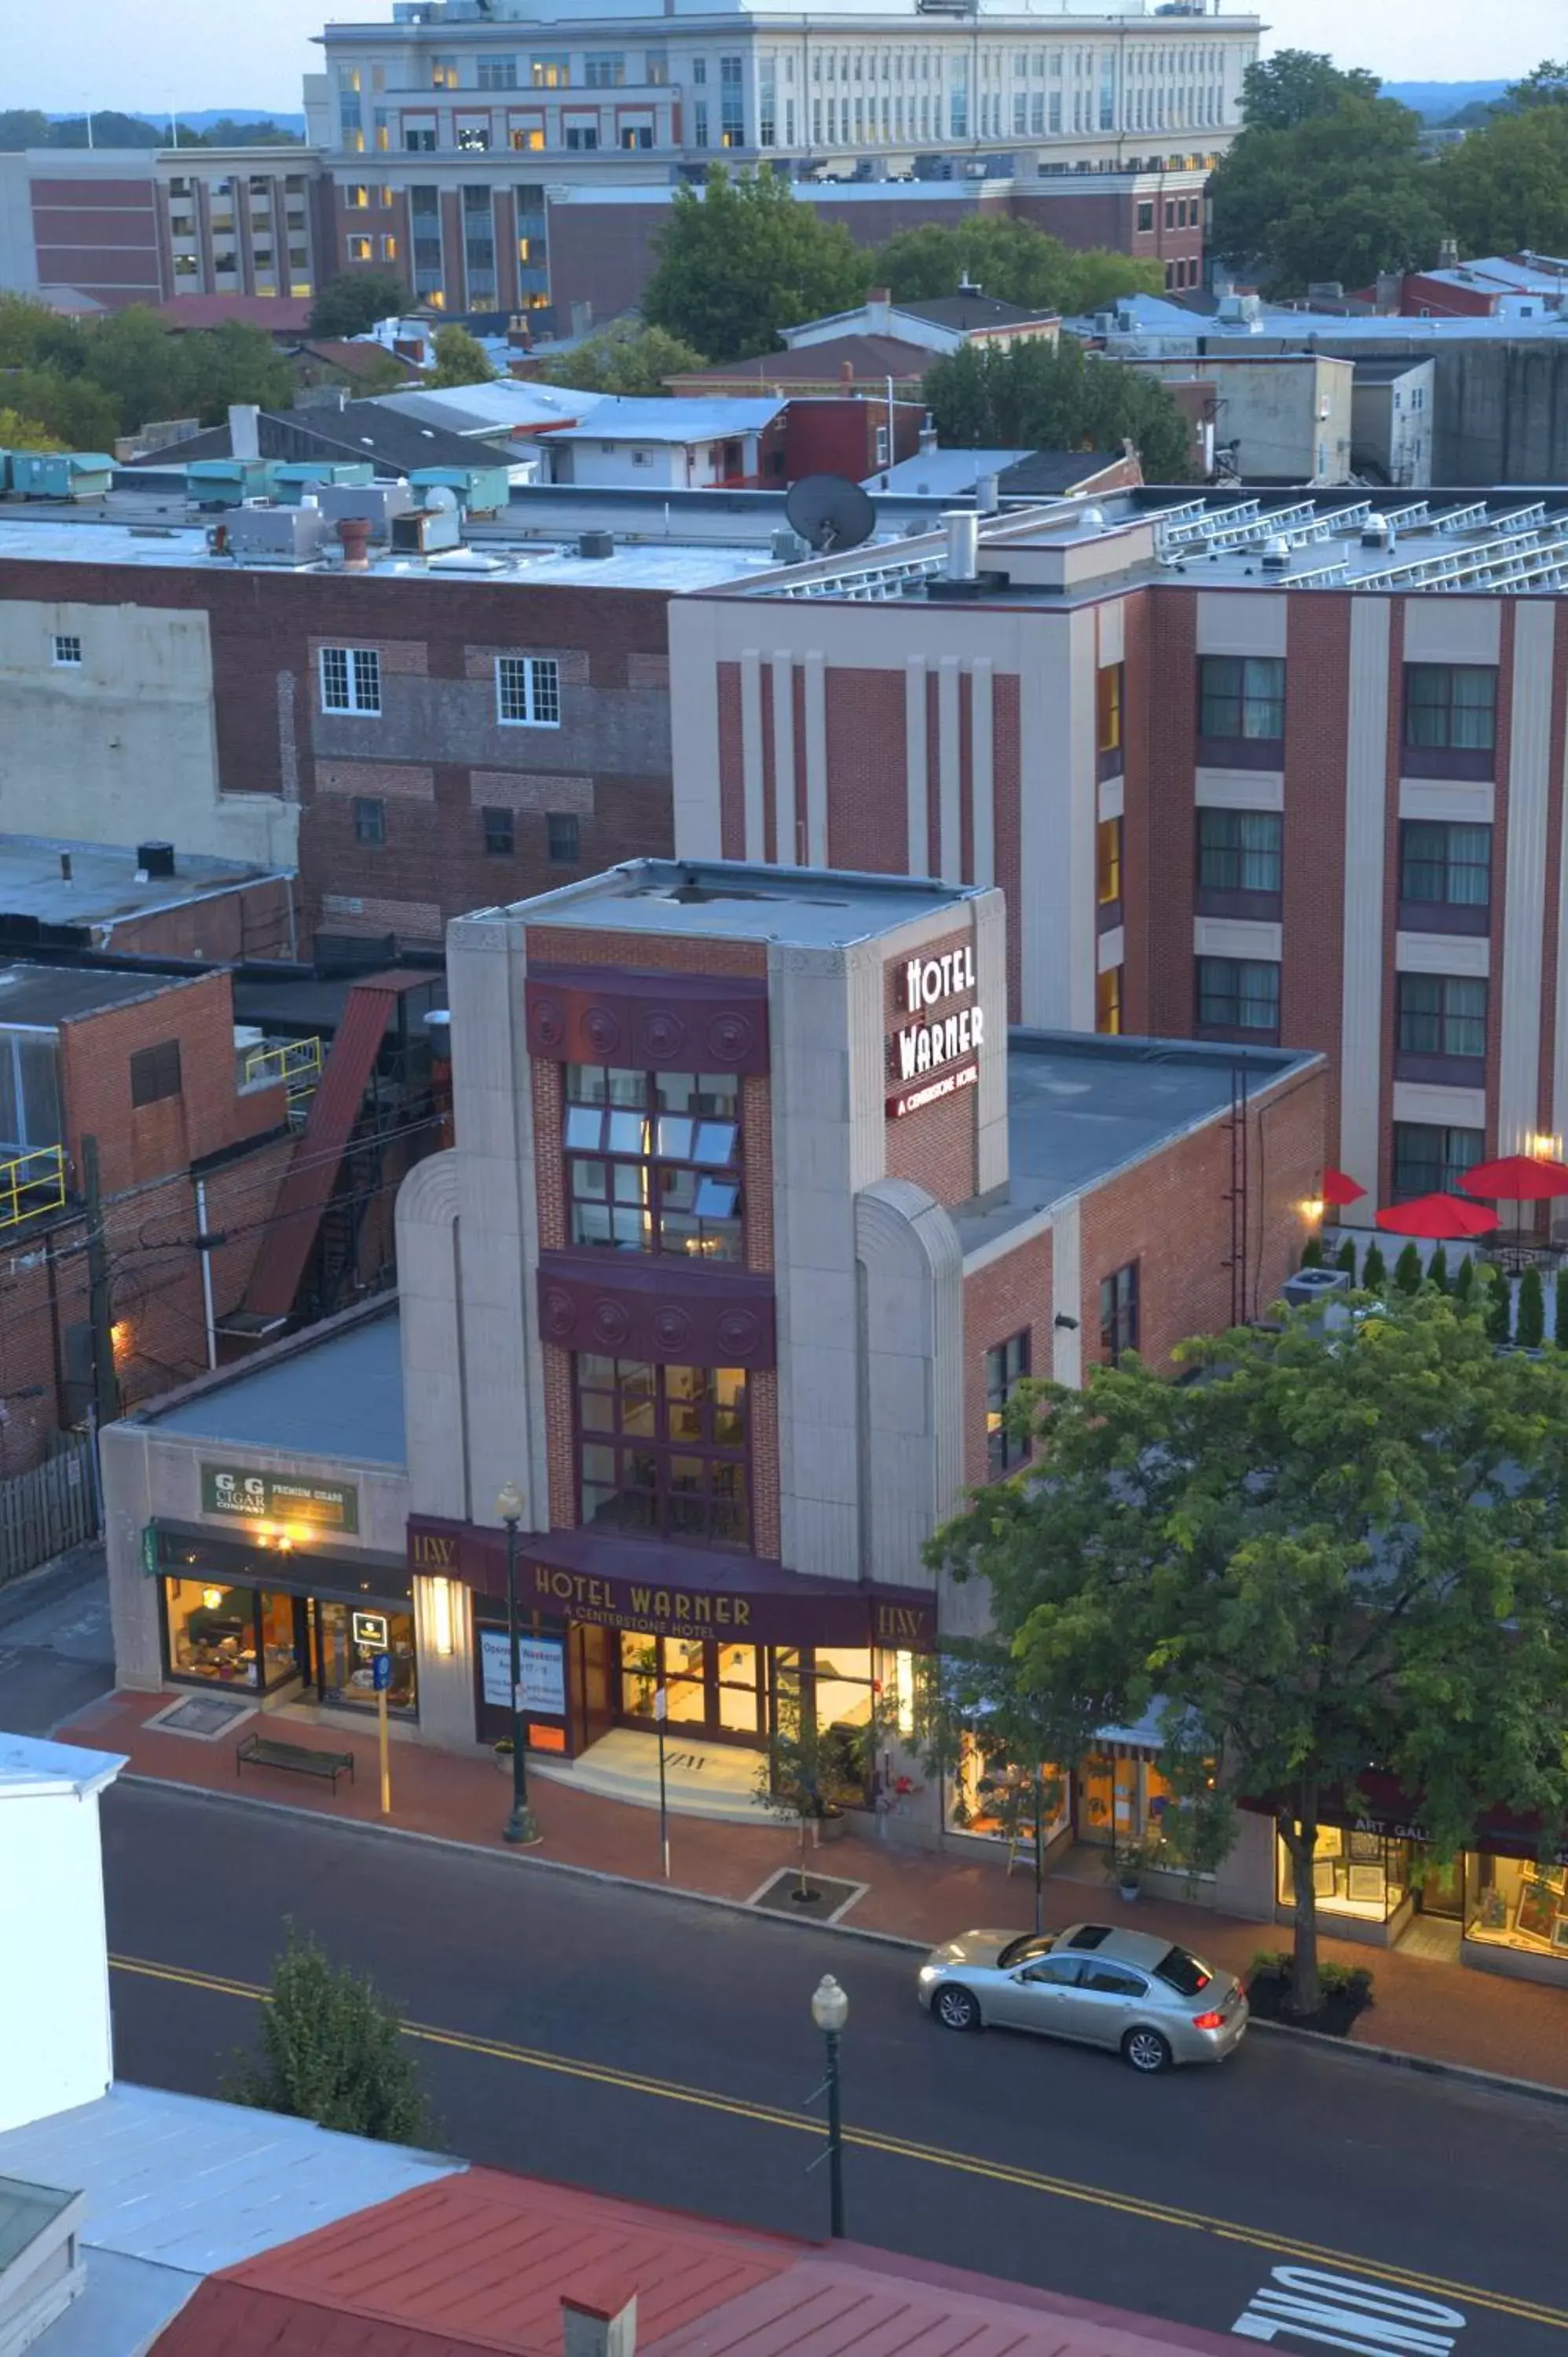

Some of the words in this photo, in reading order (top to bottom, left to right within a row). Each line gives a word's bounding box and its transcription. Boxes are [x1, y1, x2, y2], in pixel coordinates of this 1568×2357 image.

[907, 946, 975, 1013] HOTEL
[898, 1006, 984, 1080] WARNER
[898, 1099, 906, 1116] A
[216, 1490, 265, 1507] CIGAR
[217, 1501, 265, 1515] COMPANY
[535, 1565, 617, 1609] HOTEL
[630, 1585, 752, 1626] WARNER
[562, 1604, 573, 1617] A
[574, 1607, 667, 1634] CENTERSTONE
[671, 1624, 716, 1639] HOTEL
[1354, 1819, 1386, 1833] ART
[1394, 1824, 1438, 1842] GALL
